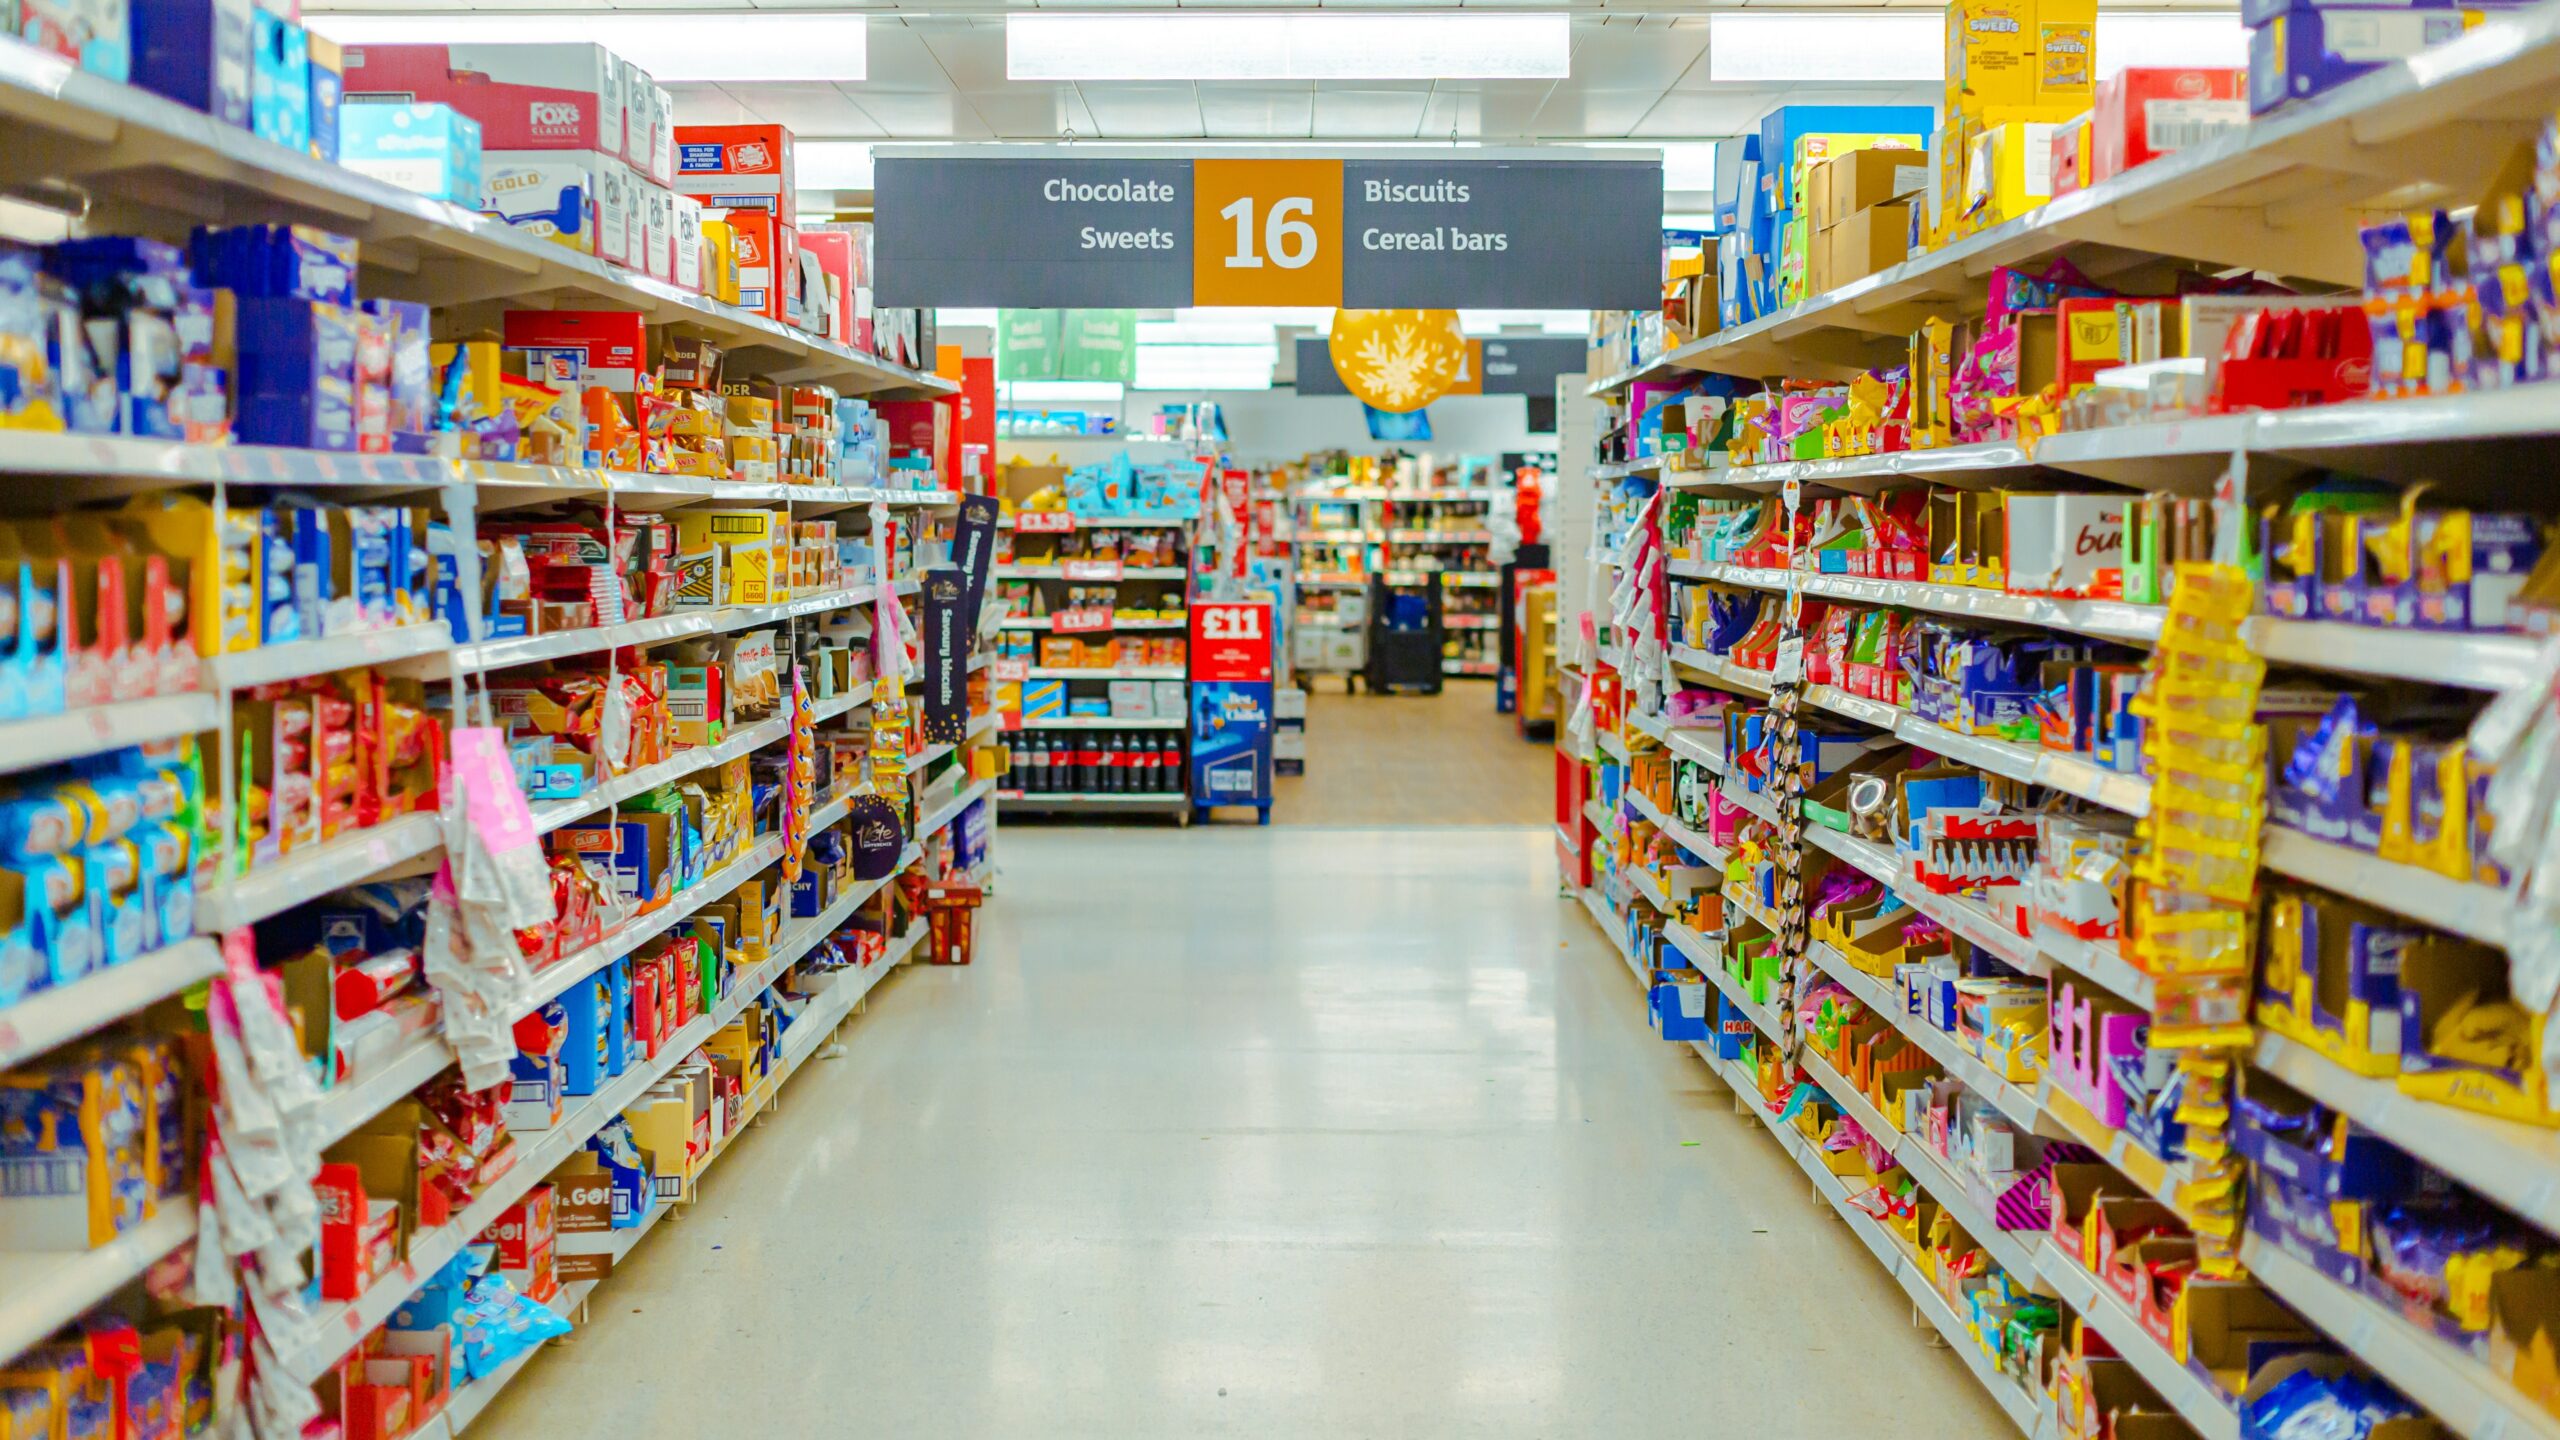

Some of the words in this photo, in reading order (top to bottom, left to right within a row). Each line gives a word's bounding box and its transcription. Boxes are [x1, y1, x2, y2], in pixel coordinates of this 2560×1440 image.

[1970, 18, 2020, 33] SWEETS
[2046, 41, 2086, 54] SWEETS
[531, 126, 579, 135] CLASSIC
[492, 173, 539, 191] GOLD
[1044, 178, 1175, 203] Chocolate
[1363, 178, 1471, 203] Biscuits
[1080, 226, 1175, 250] Sweets
[1220, 196, 1318, 269] 16
[1362, 227, 1445, 251] Cereal
[1450, 227, 1508, 251] bars
[939, 608, 953, 657] Savoury
[1202, 607, 1263, 640] £11
[940, 658, 953, 706] biscuits
[1723, 1020, 1755, 1034] HAR
[571, 1187, 611, 1206] GO!
